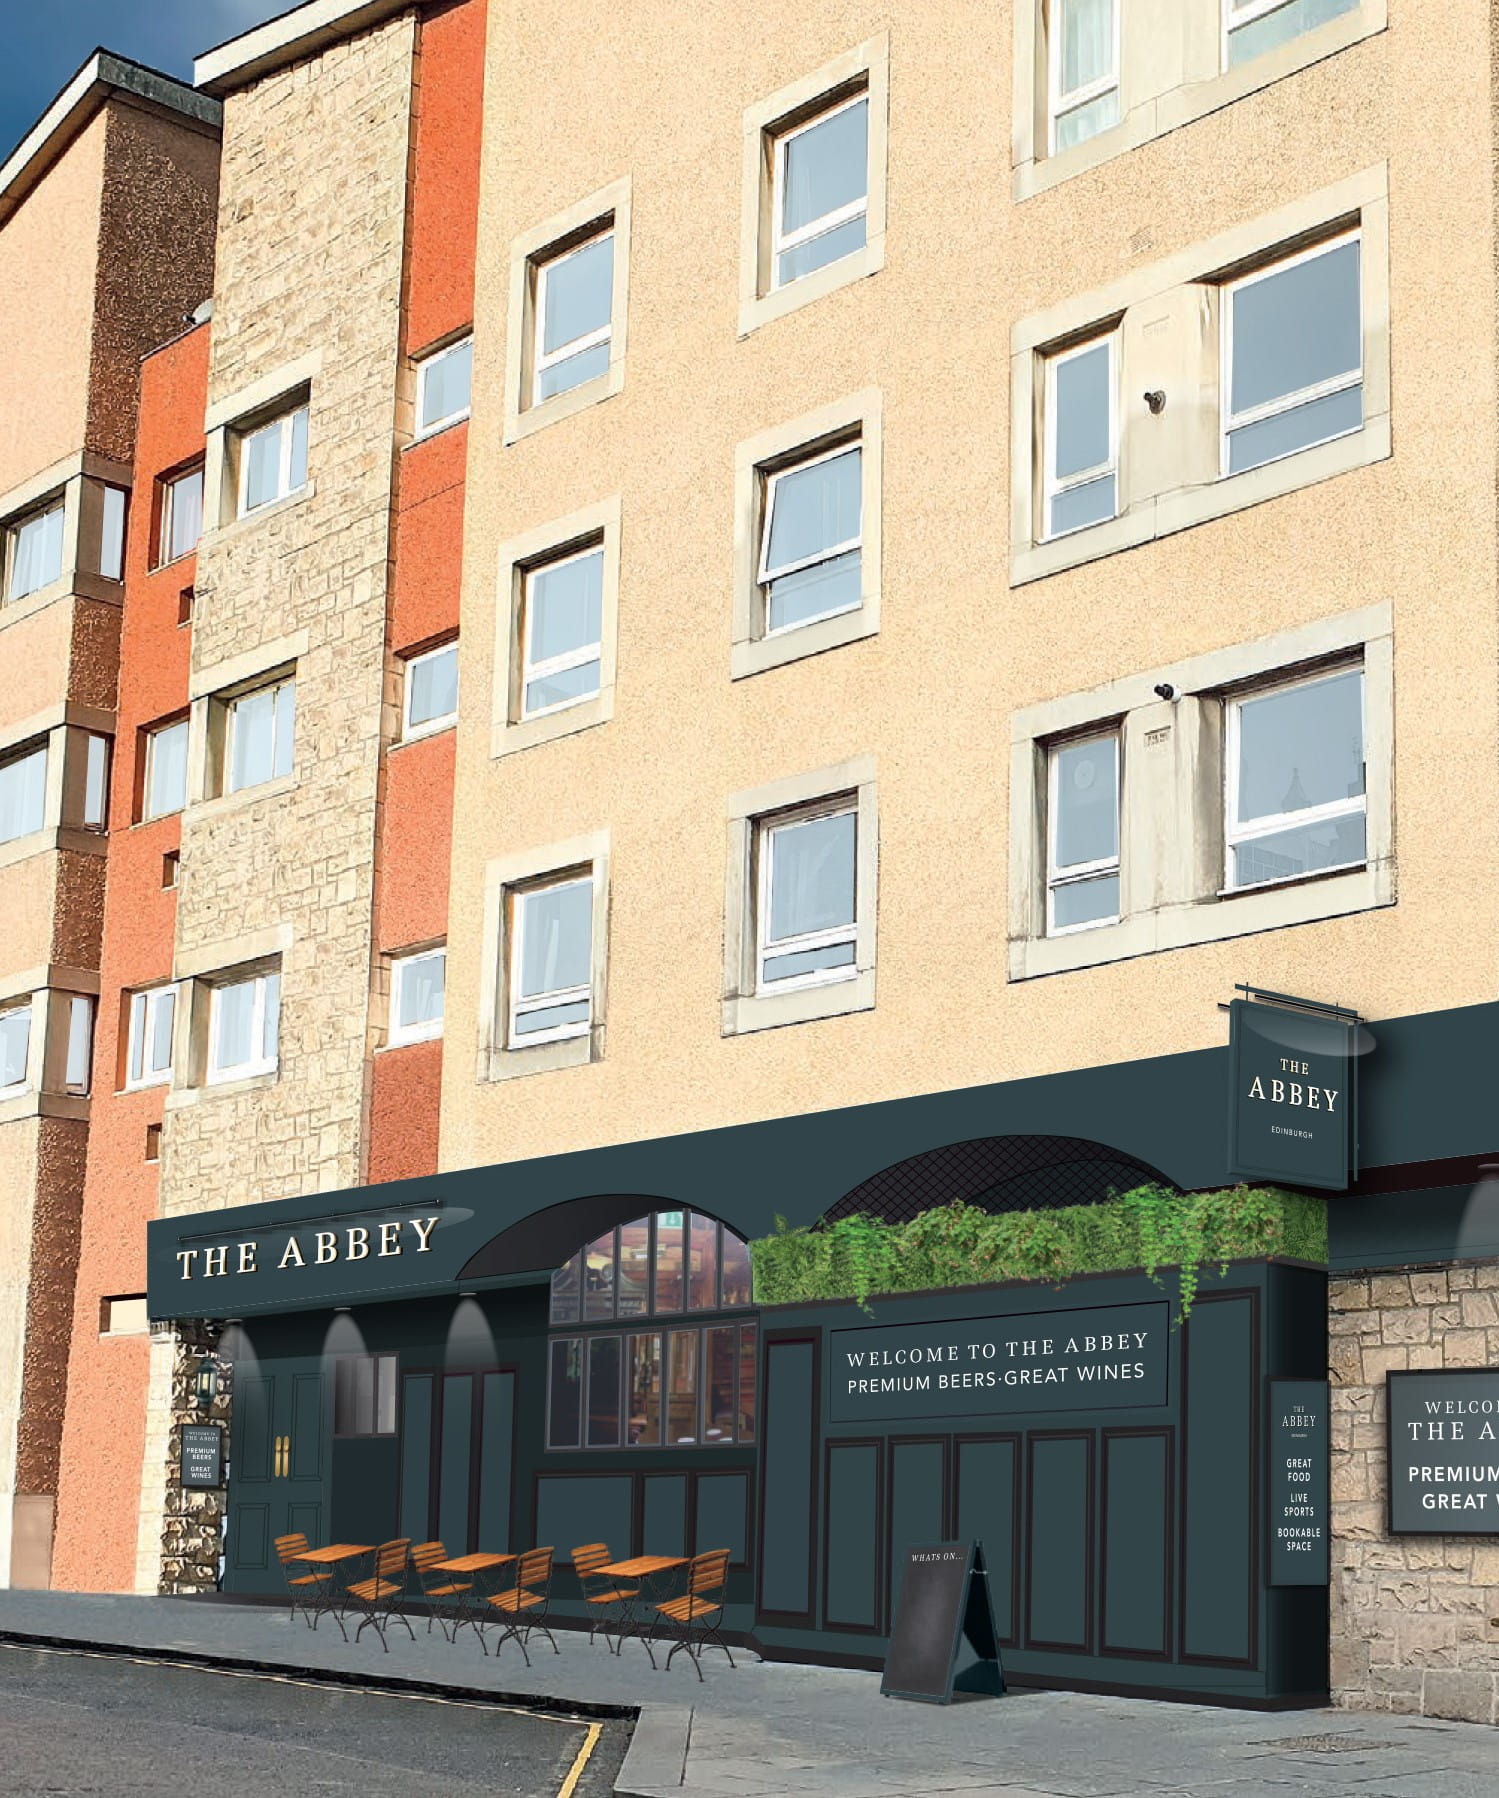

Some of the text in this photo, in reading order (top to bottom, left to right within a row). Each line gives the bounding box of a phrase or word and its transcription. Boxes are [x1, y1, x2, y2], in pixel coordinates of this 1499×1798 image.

[1280, 1058, 1309, 1075] THE
[1248, 1076, 1338, 1112] ABBEY
[1272, 1126, 1312, 1139] EDINBURGH
[176, 1217, 440, 1280] THE ABBEY
[847, 1333, 1147, 1367] WELCOME TO THE ABBEY
[849, 1376, 929, 1394] PREMIUM
[1077, 1363, 1144, 1381] WINES
[1282, 1416, 1315, 1426] ABBEY
[1408, 1422, 1463, 1440] THE
[1287, 1459, 1312, 1468] GREAT
[1288, 1472, 1310, 1481] FOOD
[1291, 1493, 1307, 1502] LIVE
[1423, 1494, 1487, 1509] GREAT
[1285, 1507, 1313, 1516] SPORTS
[1278, 1528, 1320, 1537] BOOKABLE
[1287, 1542, 1311, 1551] SPACE
[912, 1553, 941, 1562] WHATS
